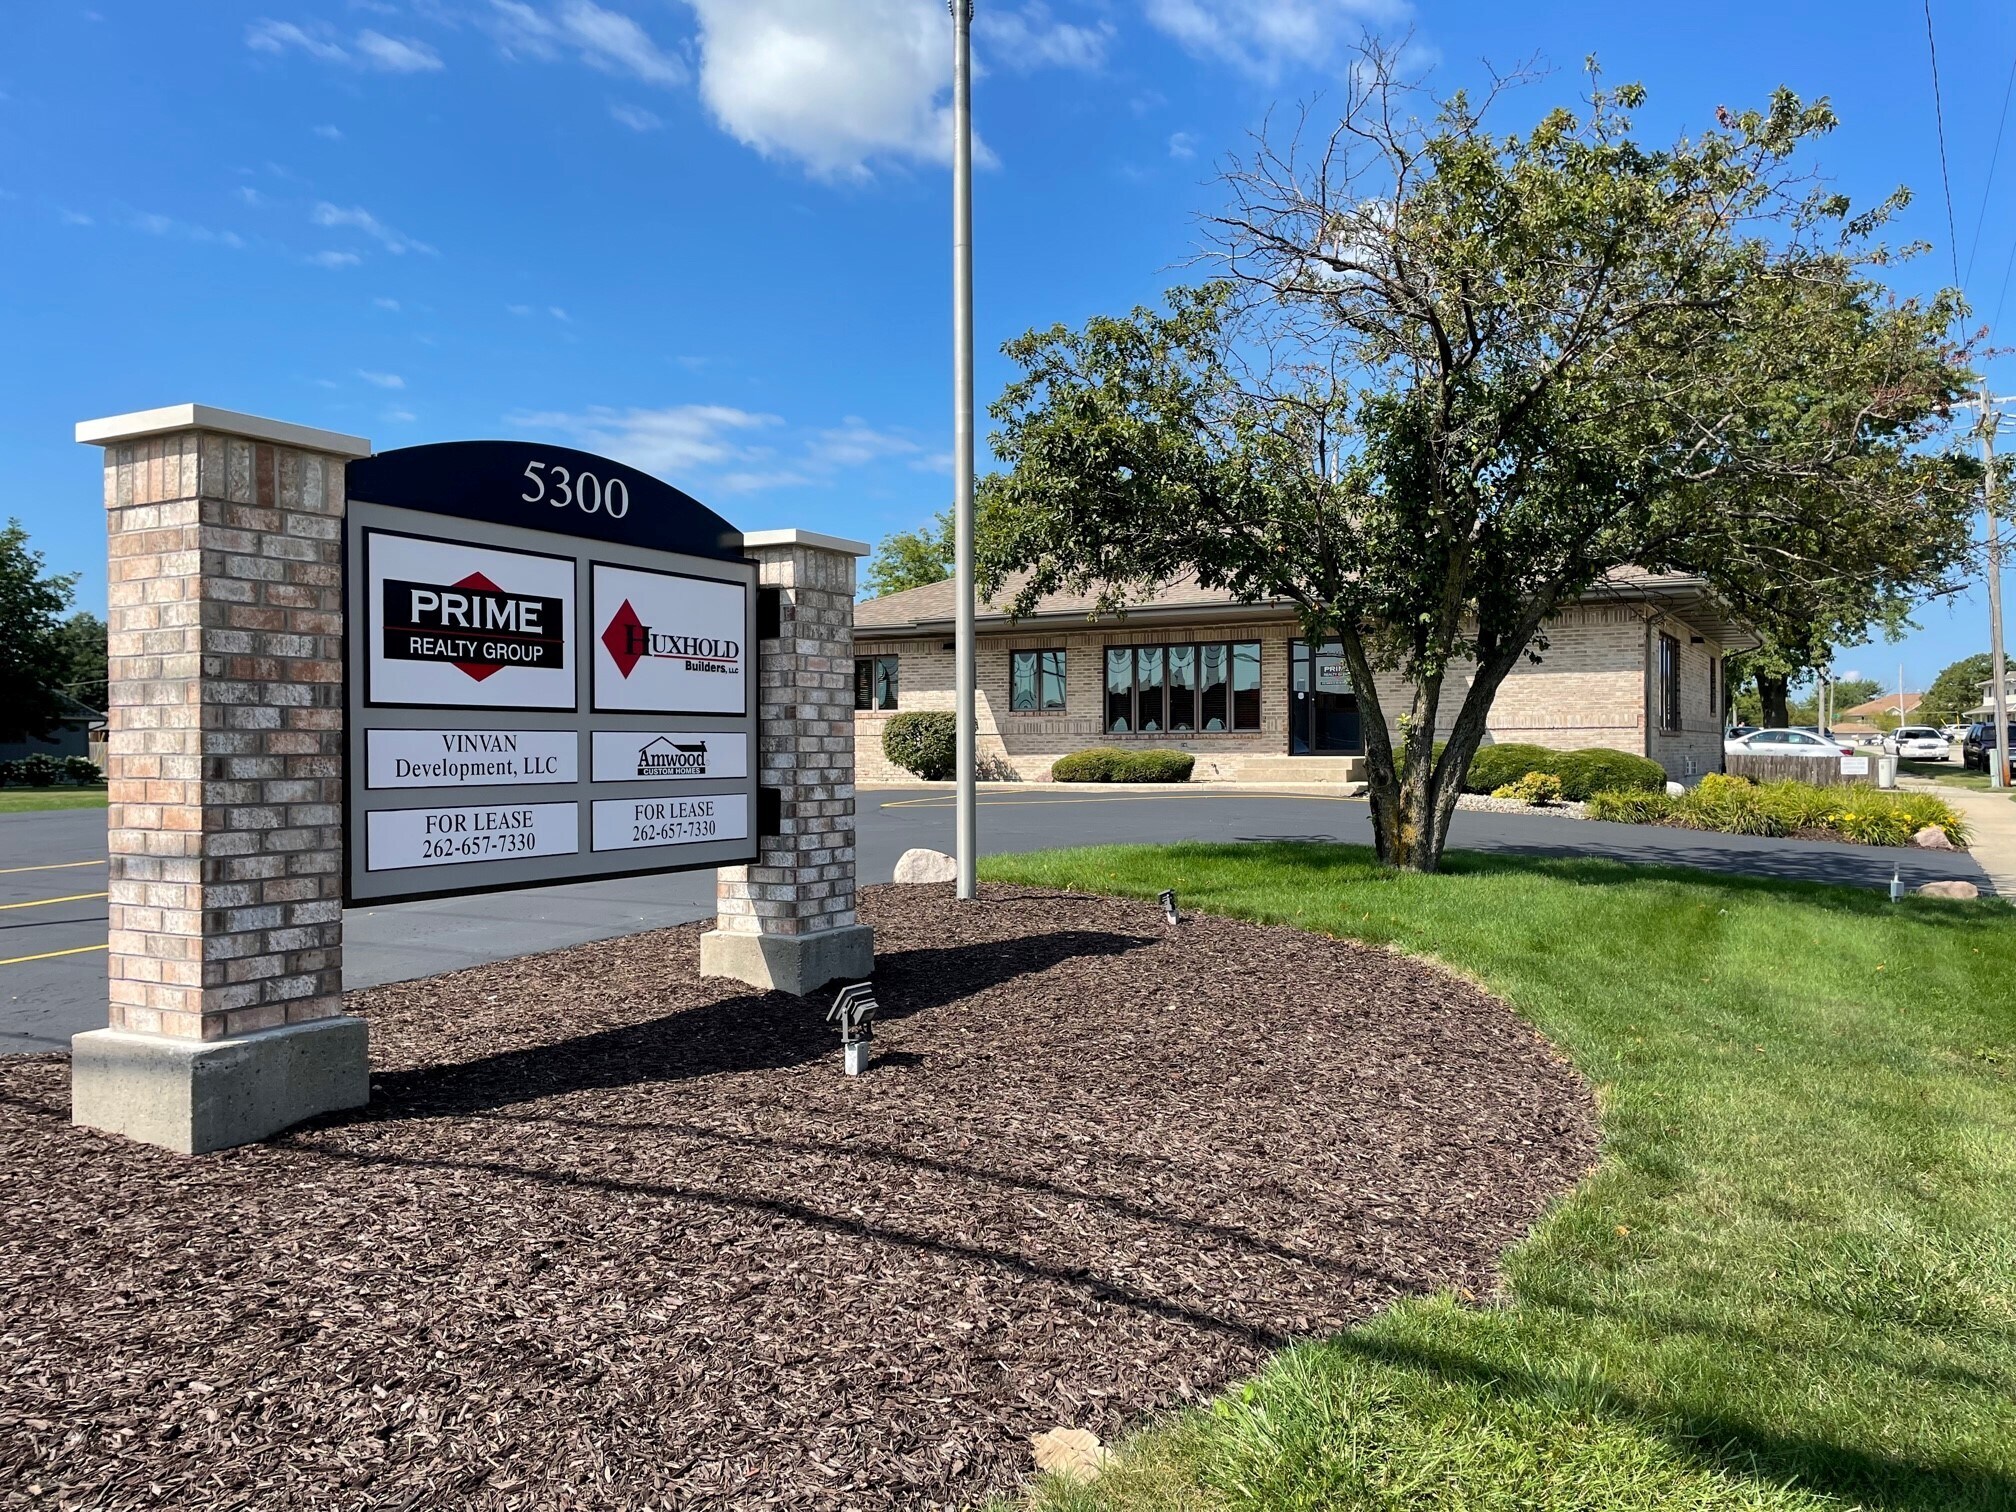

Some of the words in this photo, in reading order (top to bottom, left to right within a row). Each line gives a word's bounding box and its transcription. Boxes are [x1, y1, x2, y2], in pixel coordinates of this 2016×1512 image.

[521, 460, 629, 518] 5300
[410, 589, 543, 635] PRIME
[410, 636, 478, 658] REALTY
[483, 642, 544, 662] GROUP
[685, 660, 728, 675] Builders,
[442, 734, 518, 753] VINVAN
[395, 758, 518, 781] Development,
[523, 756, 558, 775] LLC
[637, 749, 705, 767] Amwood
[643, 767, 674, 775] CUSTOM
[425, 814, 467, 834] FOR
[473, 810, 534, 831] LEASE
[635, 804, 665, 820] FOR
[670, 801, 715, 818] LEASE
[632, 820, 716, 842] 262-657-7330
[422, 832, 536, 858] 262-657-7330
